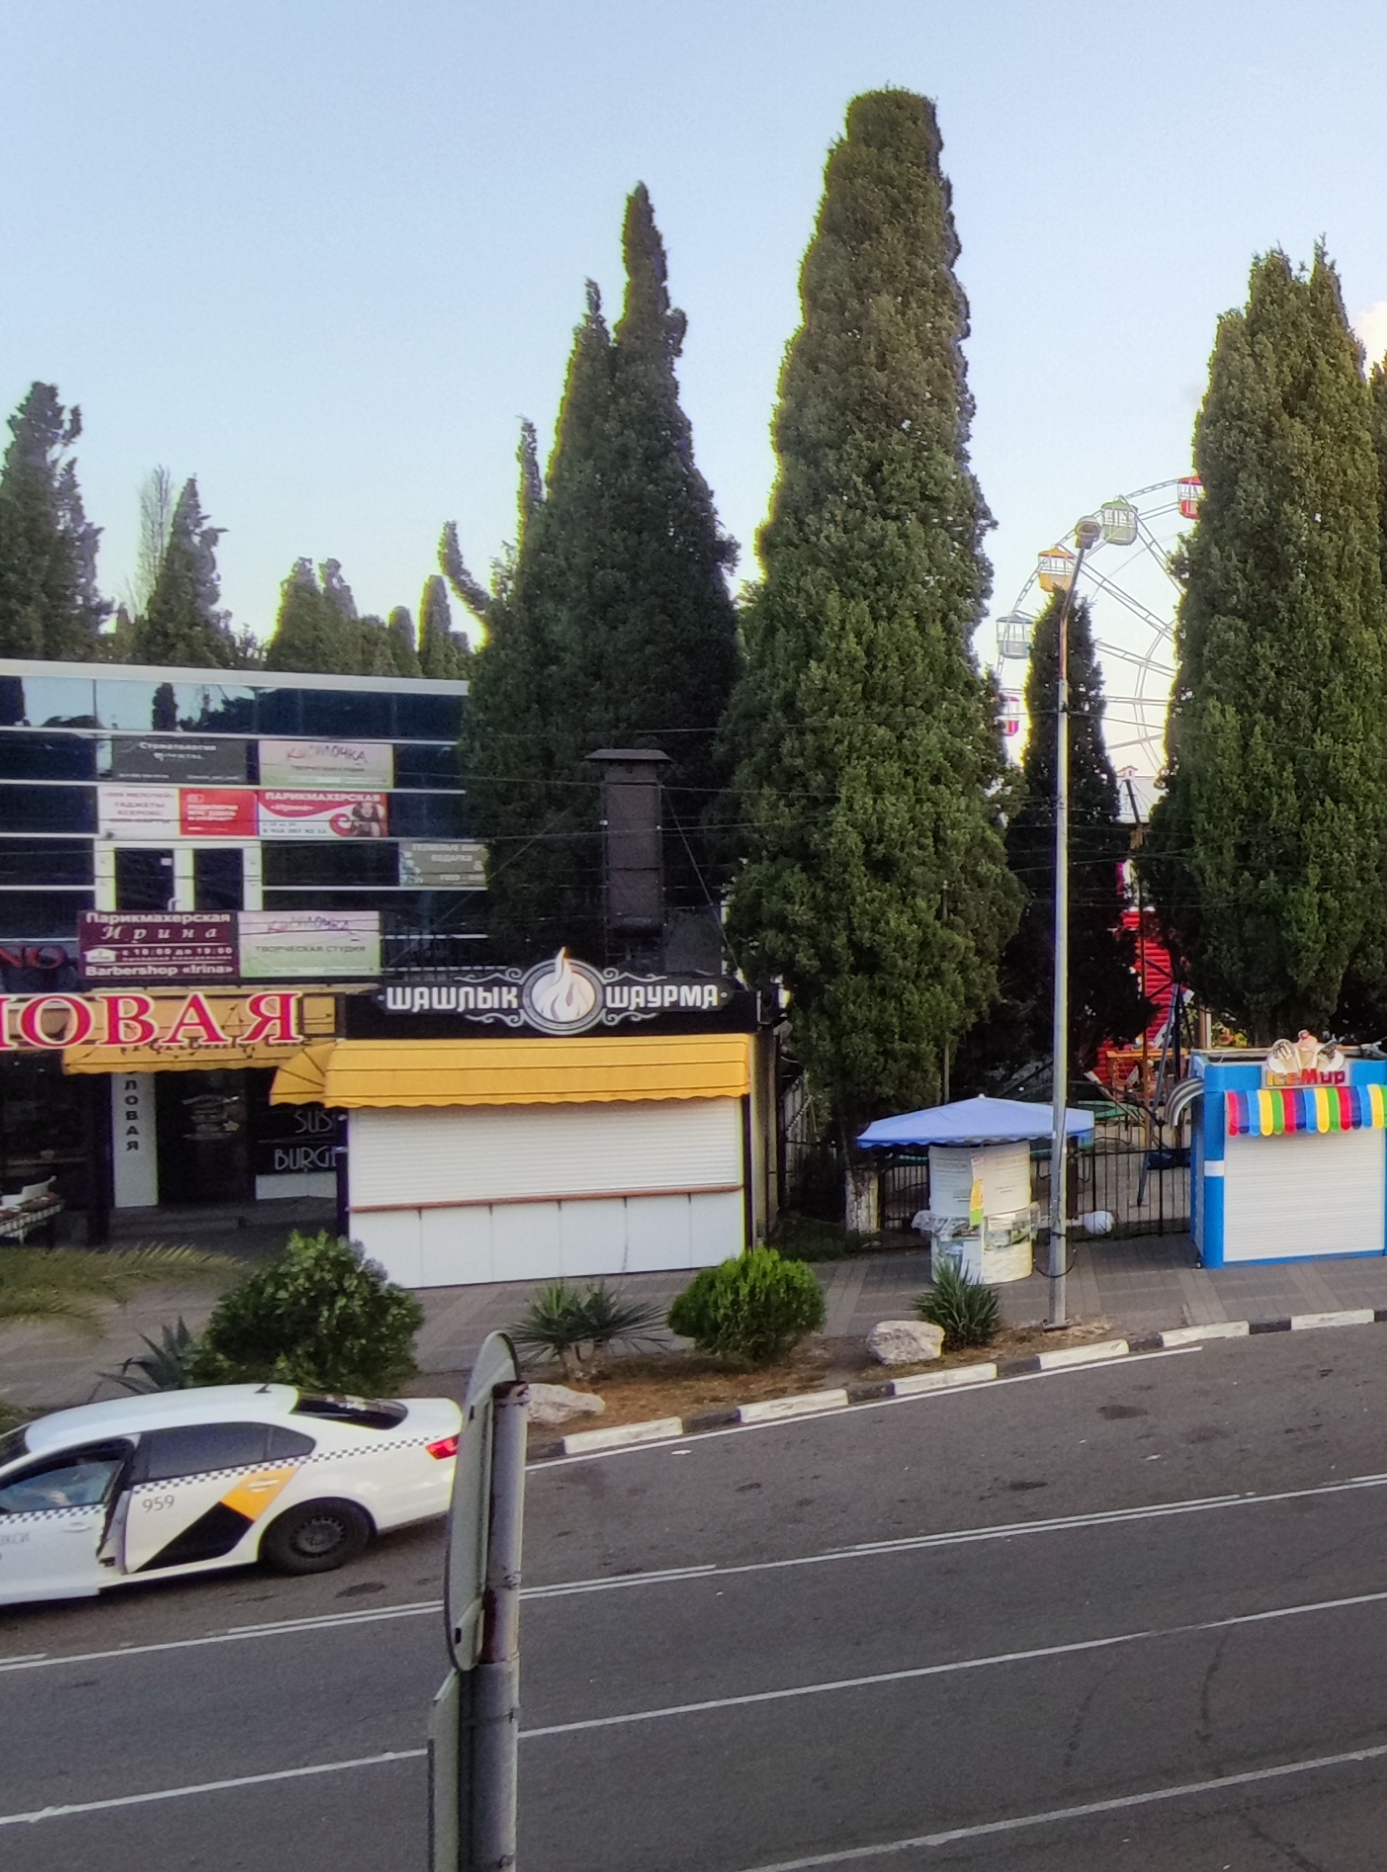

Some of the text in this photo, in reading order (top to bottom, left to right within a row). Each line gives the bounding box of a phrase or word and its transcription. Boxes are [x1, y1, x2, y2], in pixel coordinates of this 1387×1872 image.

[264, 791, 381, 802] ПАРИКМАХЕРСКАЯ
[86, 911, 230, 925] Парикмахерская
[100, 925, 219, 944] Ирина
[85, 966, 178, 977] Barbershop
[386, 984, 719, 1013] ШАШЛЫК ШАУРМА
[124, 1079, 139, 1152] ЛОВАЯ
[294, 1108, 334, 1133] SUS
[142, 1495, 175, 1512] 959
